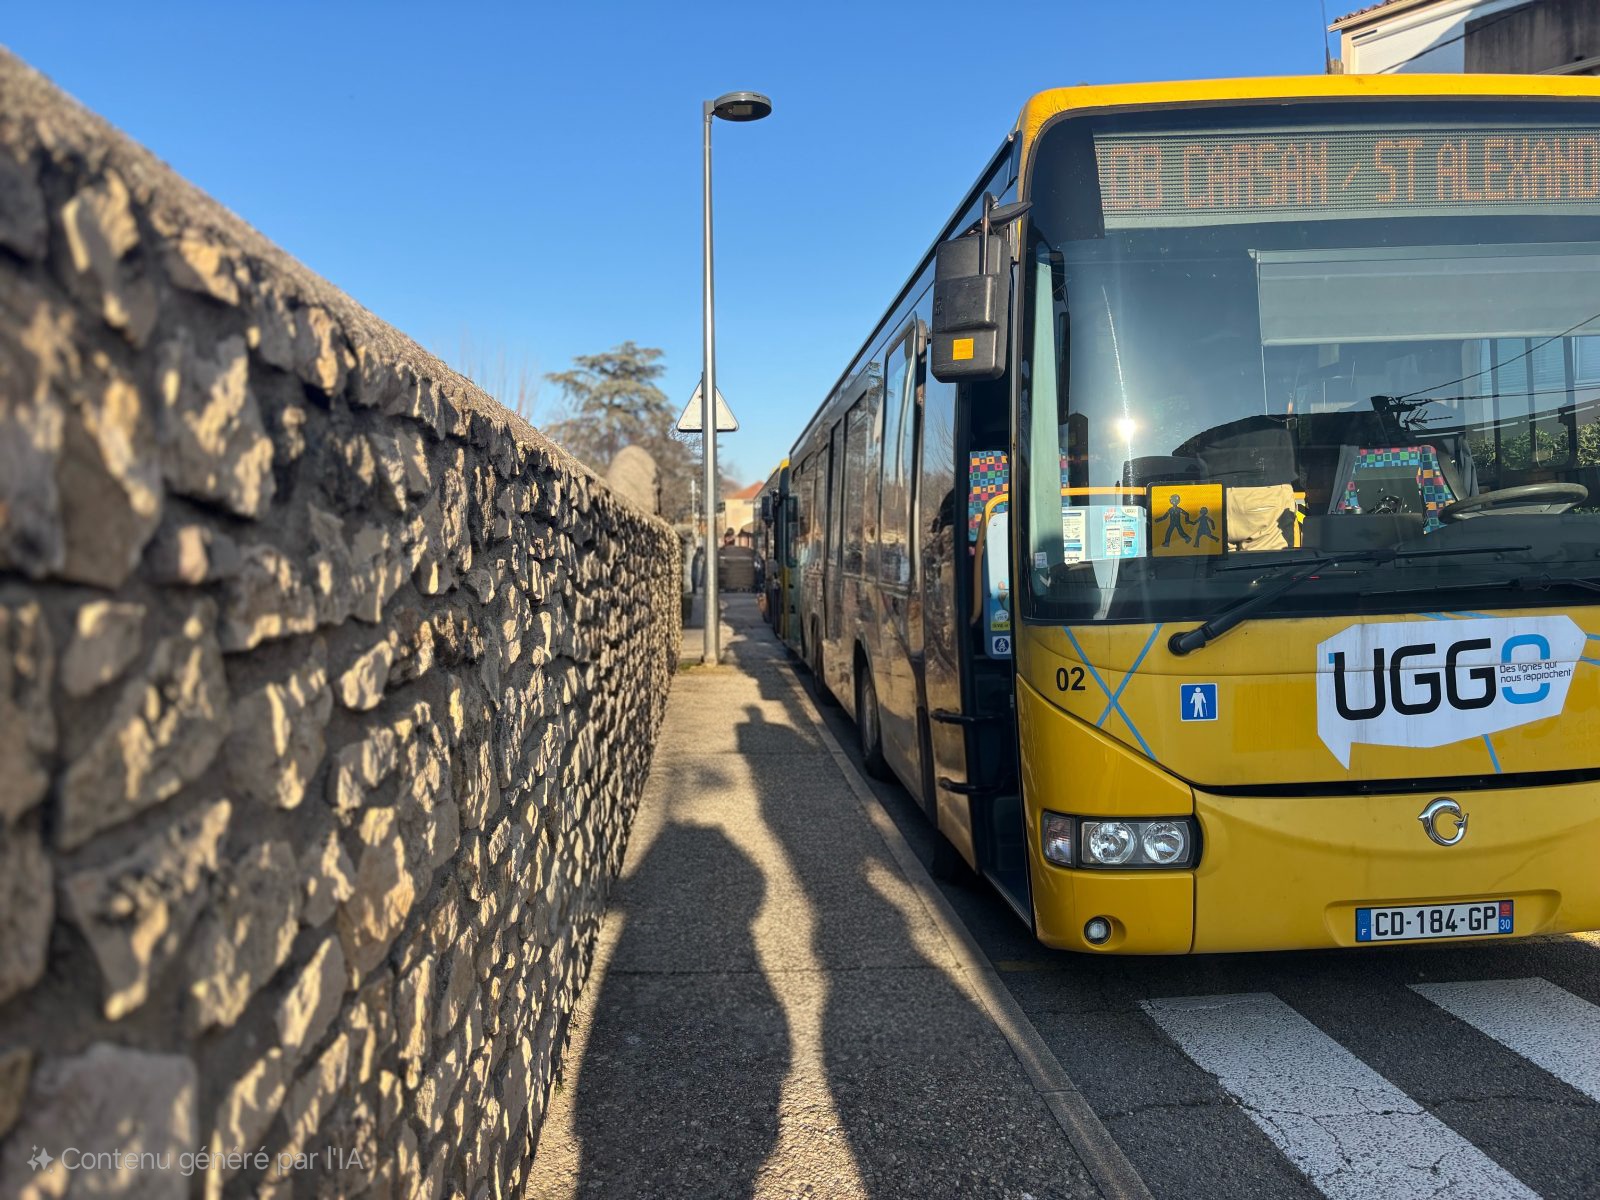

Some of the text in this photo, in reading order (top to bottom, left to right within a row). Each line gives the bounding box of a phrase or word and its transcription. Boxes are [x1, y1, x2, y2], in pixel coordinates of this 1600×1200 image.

[1182, 140, 1328, 208] CARSAN
[1374, 137, 1423, 201] ST
[1055, 666, 1086, 692] 02
[1334, 633, 1551, 721] UGGO
[1500, 661, 1558, 674] Des lignes qui
[1500, 668, 1572, 683] nous rapprochent
[1361, 905, 1511, 937] F CD-184-GP 30
